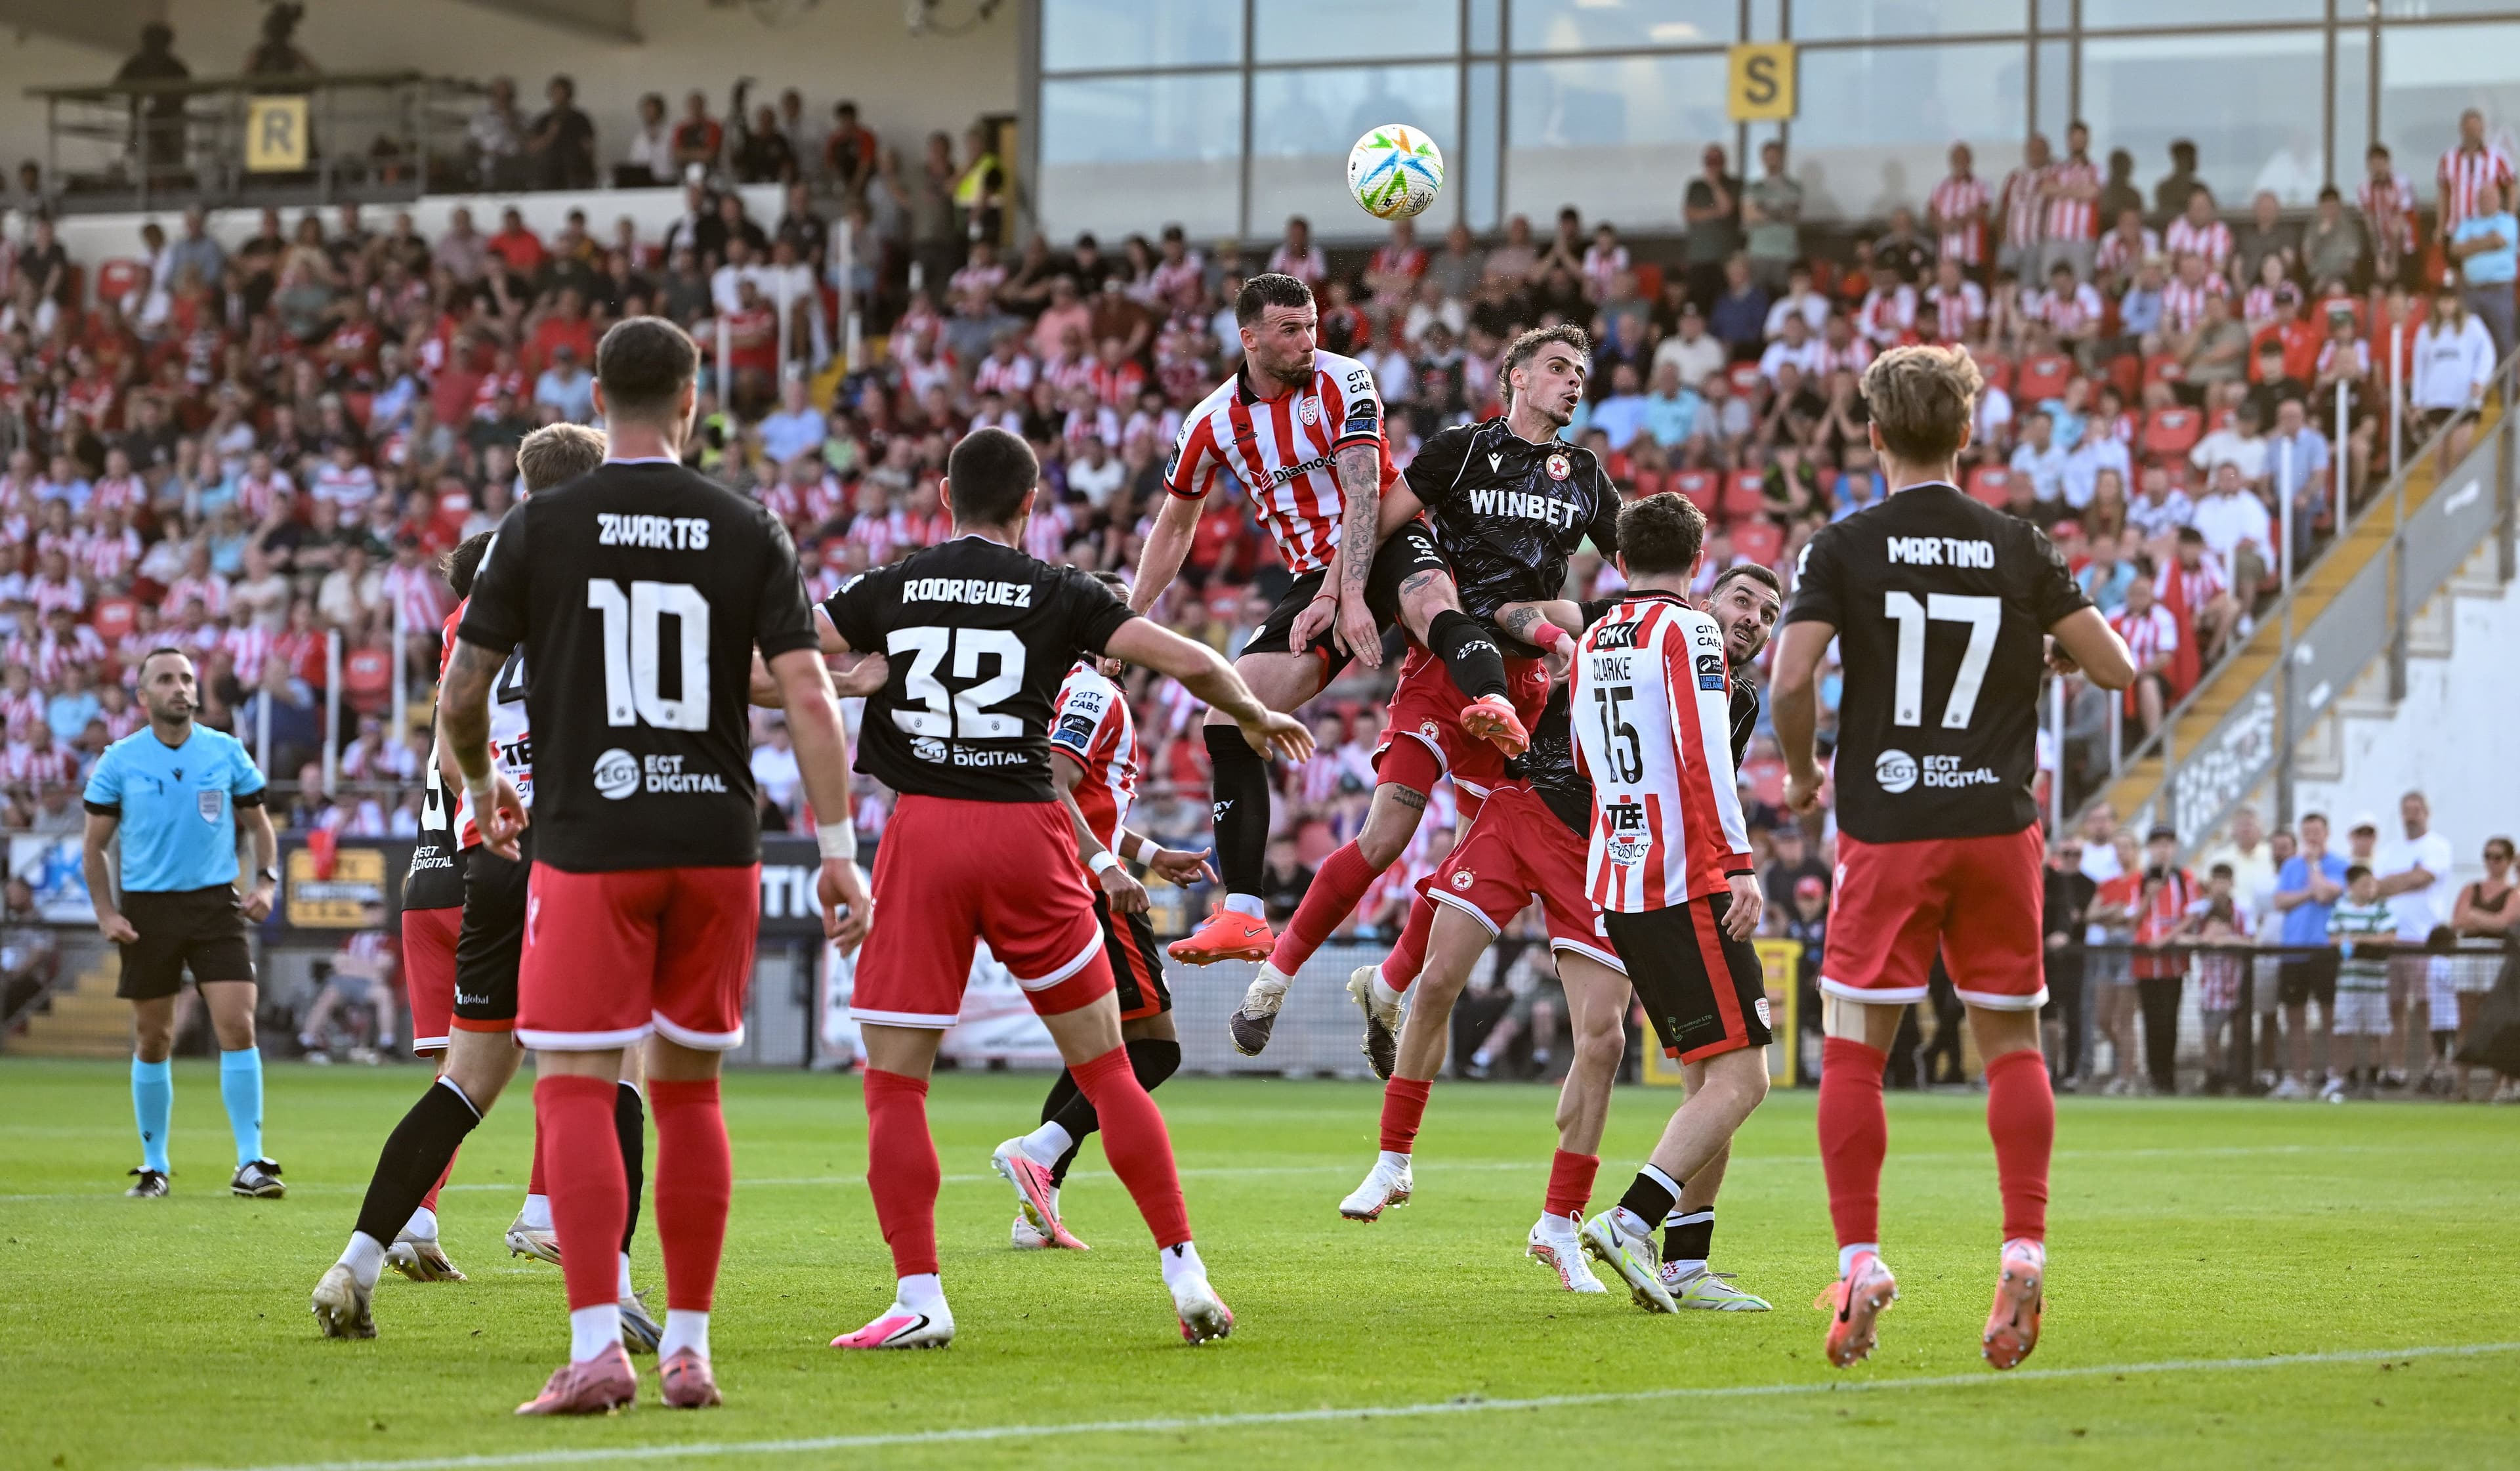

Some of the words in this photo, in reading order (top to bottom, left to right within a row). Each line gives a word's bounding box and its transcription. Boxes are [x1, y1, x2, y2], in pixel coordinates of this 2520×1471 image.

[1745, 54, 1779, 105] S
[262, 109, 293, 153] R
[1469, 489, 1580, 530] WINBET
[598, 513, 710, 550] ZWARTS
[1407, 535, 1433, 549] 3
[1887, 536, 1995, 569] MARTINO
[902, 578, 1032, 608] RODRIGUEZ
[588, 578, 711, 731] 10
[1885, 591, 2002, 729] 17
[1593, 657, 1631, 681] CLARKE
[886, 626, 1026, 739] 32
[1070, 700, 1100, 714] CABS
[1076, 691, 1103, 702] CITY
[1595, 686, 1643, 784] 15
[644, 754, 684, 774] EGT
[954, 751, 1028, 767] DIGITAL
[1922, 756, 1962, 771] EGT
[646, 773, 728, 793] DIGITAL
[1923, 767, 2001, 788] DIGITAL
[419, 845, 439, 857] EGT
[415, 855, 453, 871] DIGITAL
[463, 993, 489, 1004] global
